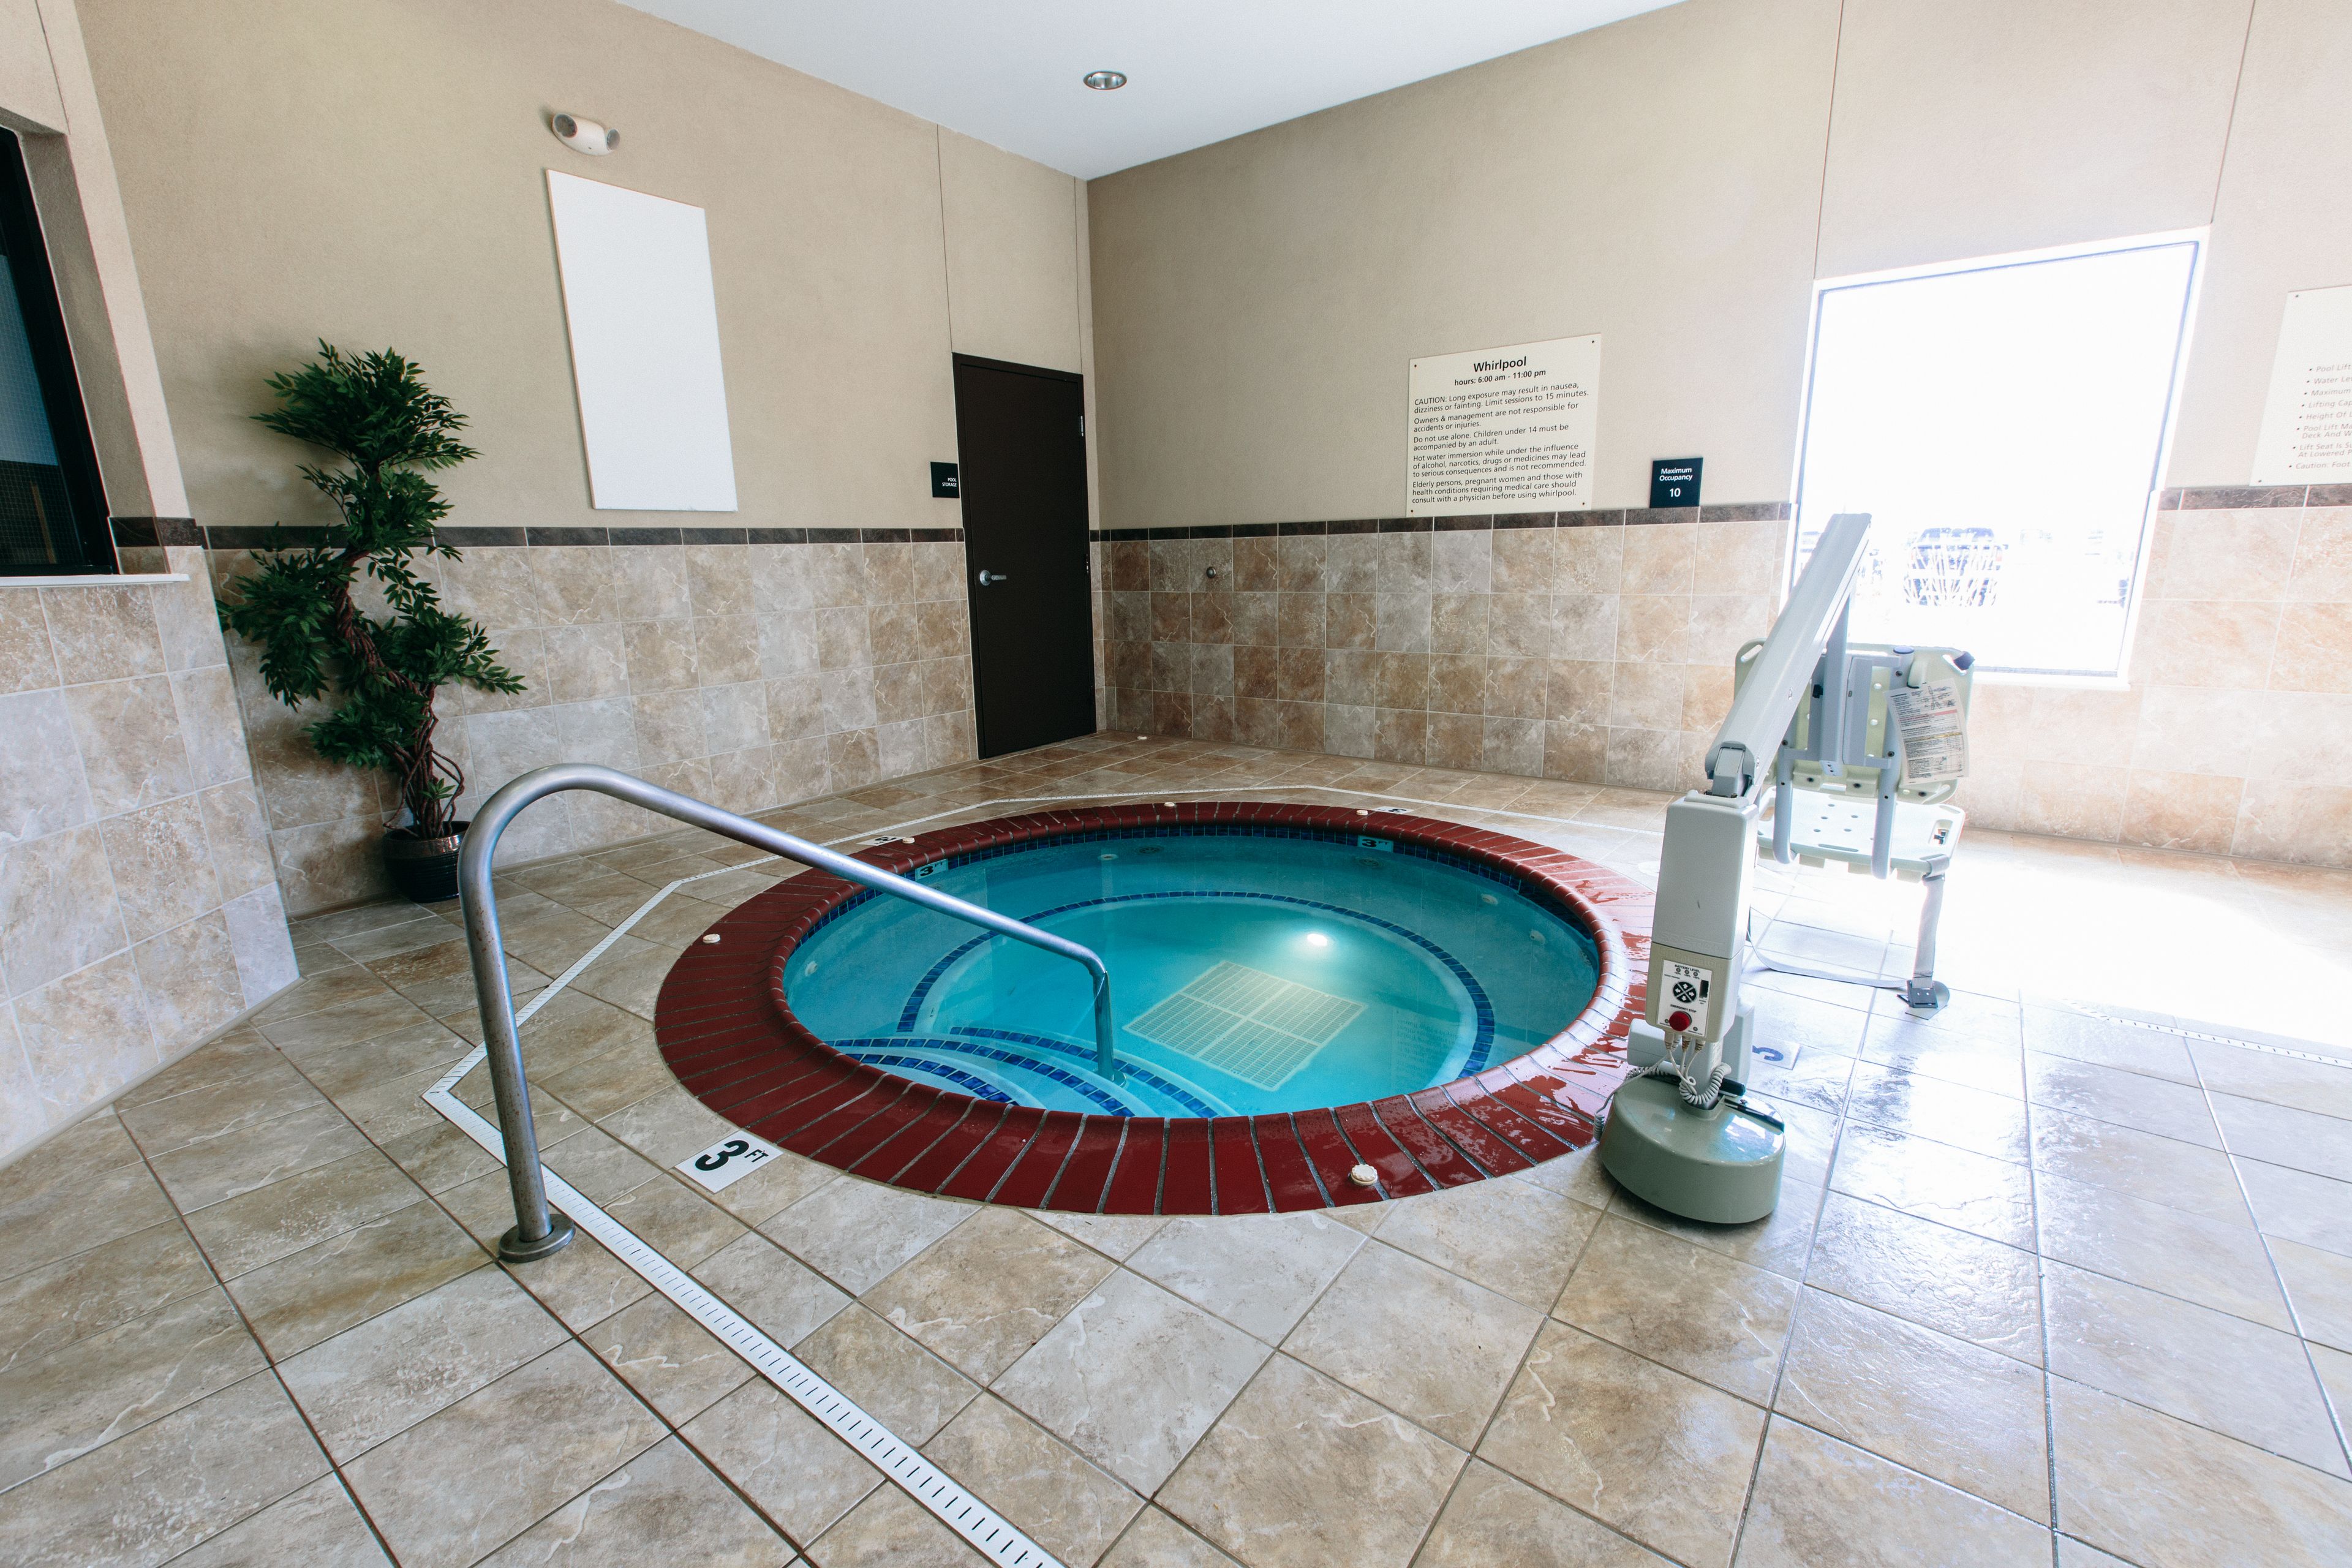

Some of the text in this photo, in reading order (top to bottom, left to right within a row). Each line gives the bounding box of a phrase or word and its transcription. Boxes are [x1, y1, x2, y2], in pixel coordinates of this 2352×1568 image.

[1473, 356, 1526, 372] Whirlpool
[1414, 396, 1447, 405] CAUTION:
[1468, 391, 1499, 401] exposure
[1518, 386, 1539, 394] result
[1414, 405, 1443, 413] dizziness
[1454, 401, 1483, 410] fainting.
[1504, 396, 1532, 404] sessions
[1447, 412, 1493, 421] management
[1523, 403, 1565, 414] responsible
[2306, 412, 2334, 421] Height
[1414, 424, 1444, 432] accidents
[1455, 421, 1481, 430] injuries.
[1413, 442, 1457, 451] accompanied
[1458, 440, 1466, 449] by
[1446, 467, 1492, 475] consequences
[1531, 460, 1586, 470] recommended.
[1465, 477, 1496, 486] pregnant
[1539, 489, 1577, 497] whirlpool.
[1669, 488, 1681, 497] 10
[1362, 839, 1377, 848] 3
[919, 865, 934, 876] 3
[695, 1139, 769, 1172] 3 FT
